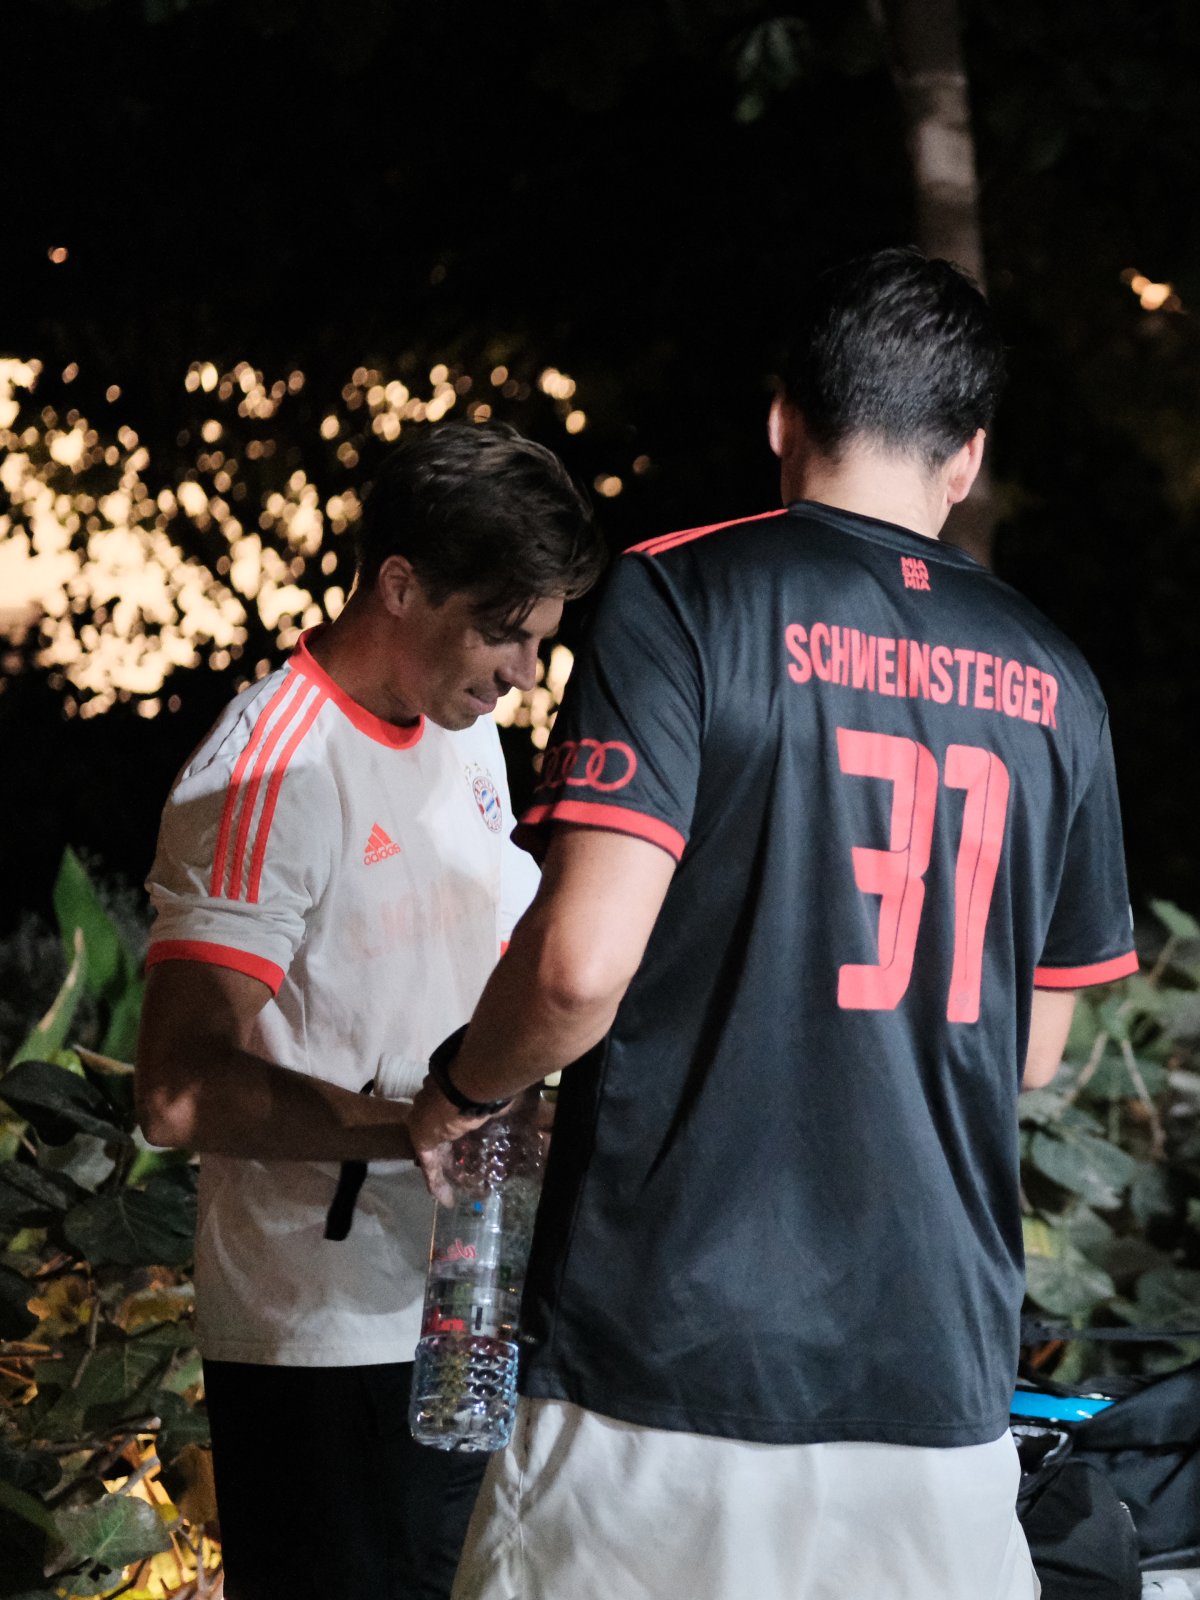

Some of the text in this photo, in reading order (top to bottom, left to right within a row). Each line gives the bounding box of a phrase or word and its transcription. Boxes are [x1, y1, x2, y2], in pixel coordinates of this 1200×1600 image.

[904, 576, 931, 590] MIA
[785, 622, 1057, 730] SCHWEINSTEIGER
[363, 842, 401, 865] adidas
[836, 727, 1010, 1023] 31
